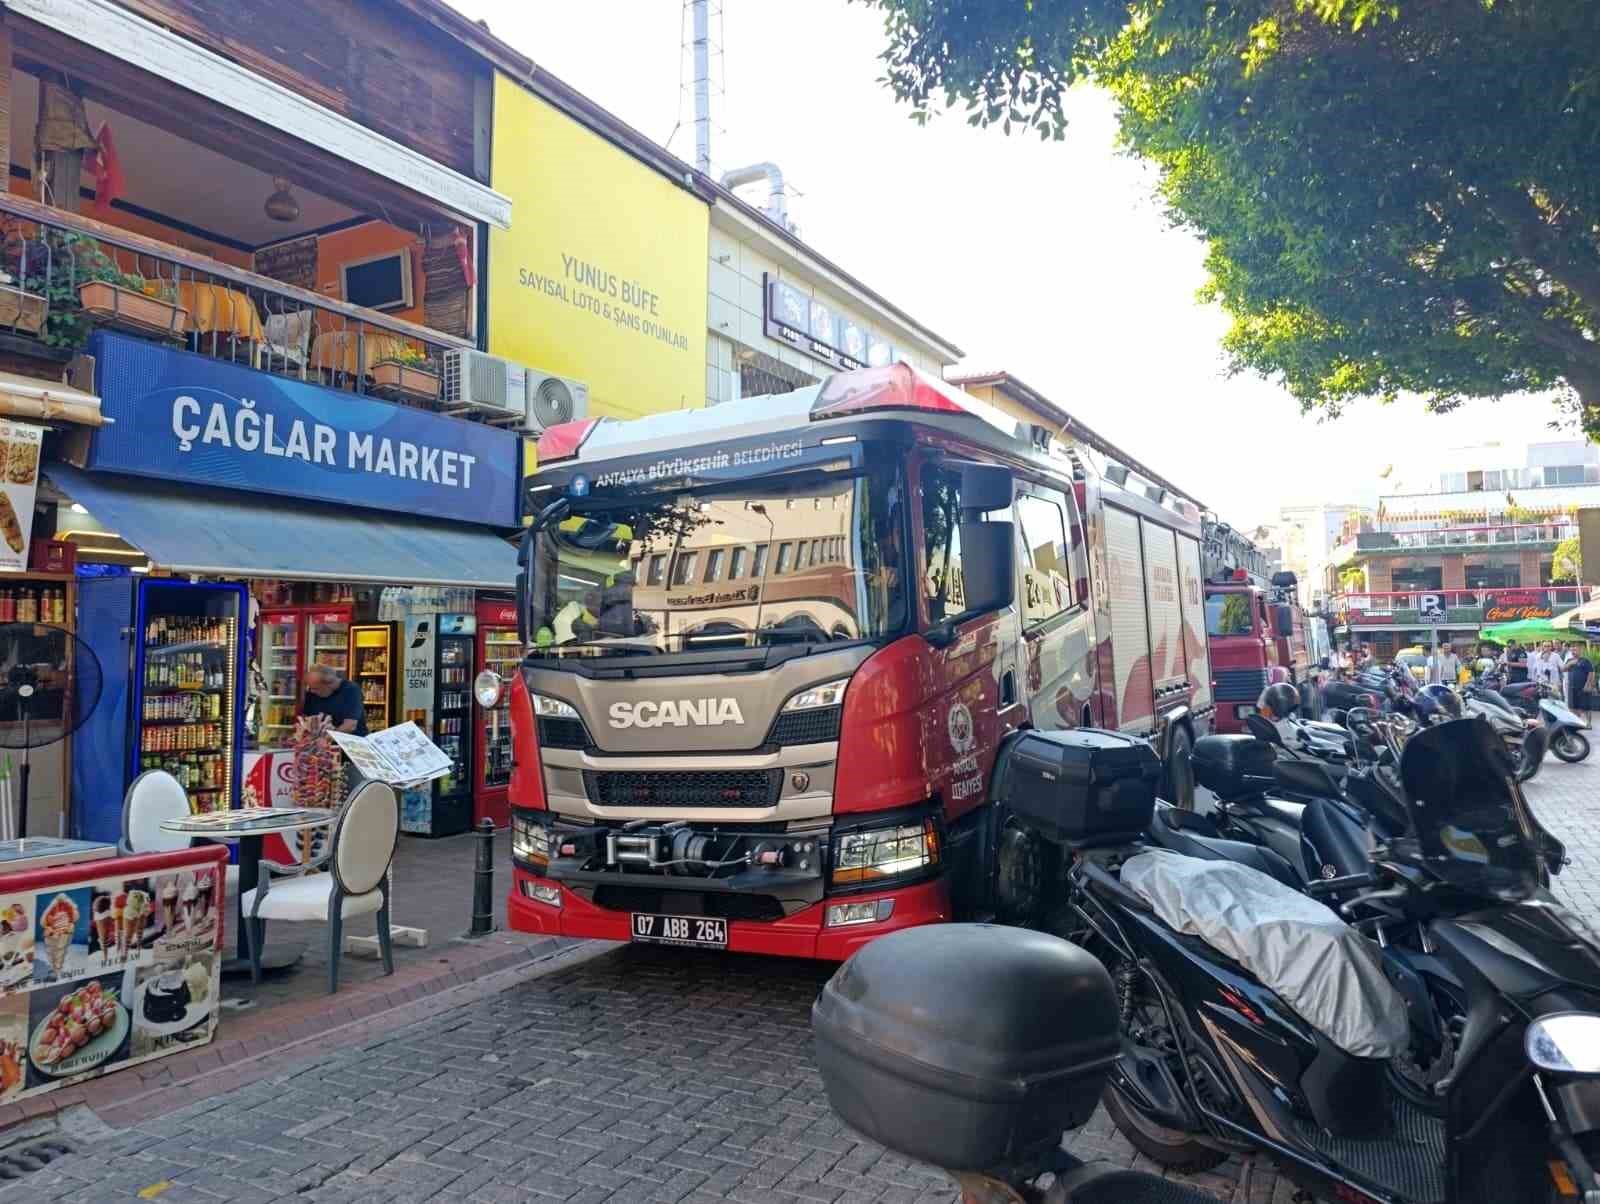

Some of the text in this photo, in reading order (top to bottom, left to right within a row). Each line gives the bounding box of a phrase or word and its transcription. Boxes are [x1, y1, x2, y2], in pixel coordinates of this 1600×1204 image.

[519, 267, 689, 351] SAYISAL LOTO & ŞANS OYUNLARI
[561, 252, 660, 317] YUNUS BÜFE
[172, 395, 476, 489] ÇAĞLAR MARKET
[595, 440, 803, 488] ANTALYA BÜYÜKŞEHİR BELEDİYESİ
[608, 698, 745, 729] SCANIA
[637, 916, 724, 942] 07 ABB 264
